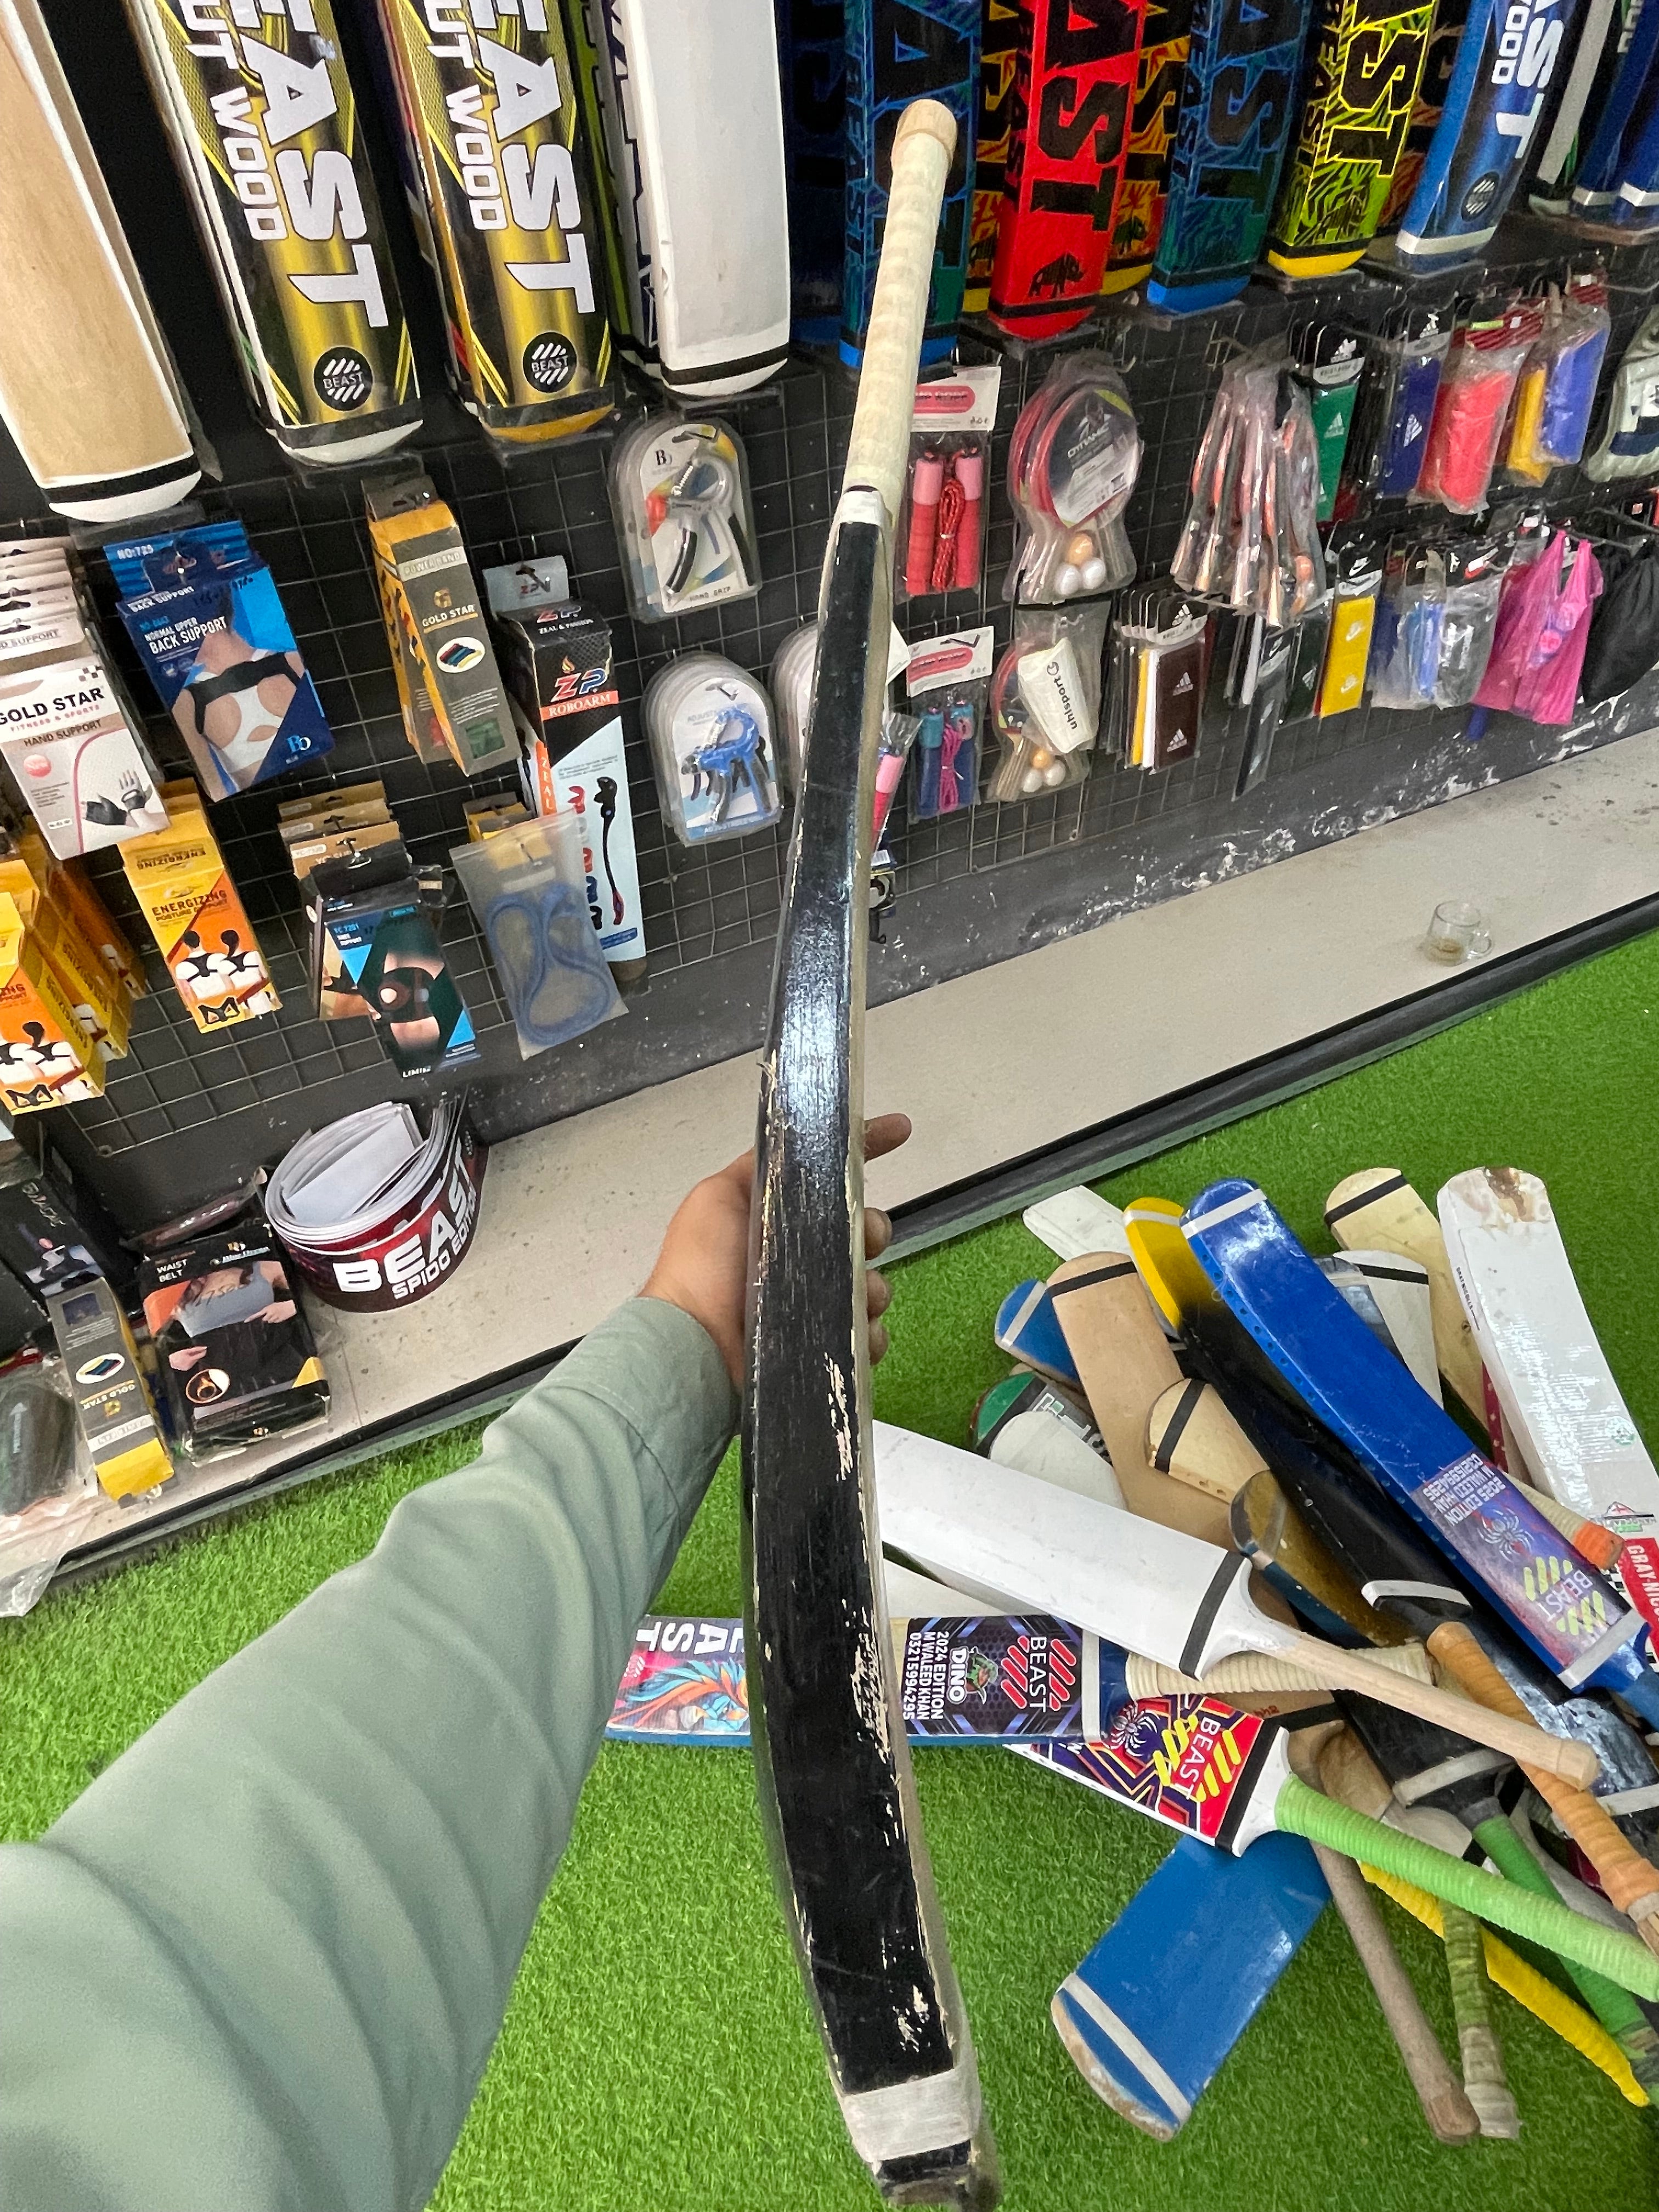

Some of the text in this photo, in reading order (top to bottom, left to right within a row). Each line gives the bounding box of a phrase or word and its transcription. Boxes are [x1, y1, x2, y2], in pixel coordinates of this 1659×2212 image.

[1491, 0, 1531, 84] OOD
[210, 87, 288, 240] WOOD
[445, 84, 507, 231] WOOD
[323, 371, 365, 390] BEAST
[531, 355, 570, 374] BEAST
[149, 636, 182, 654] BACK
[182, 616, 227, 644] SUPPORT
[422, 604, 476, 627] GOLD STAR
[53, 688, 105, 711] STAR
[549, 693, 611, 717] ROBOARM
[1053, 675, 1078, 730] uhlsport
[23, 720, 102, 747] HAND SUPPORT
[151, 890, 227, 916] ENERGIZING
[332, 1136, 472, 1293] BEAST
[157, 1259, 188, 1274] WAIST
[159, 1269, 183, 1283] BELT
[392, 1249, 451, 1300] SPIDO
[1537, 1570, 1594, 1622] BEAST
[902, 1632, 922, 1721] 03215994295
[916, 1631, 936, 1720] M WALEED KHAN
[930, 1630, 950, 1720] 2024 EDITION
[950, 1648, 967, 1702] DINO
[1029, 1636, 1047, 1713] BEAST
[1176, 1716, 1222, 1801] BEAST
